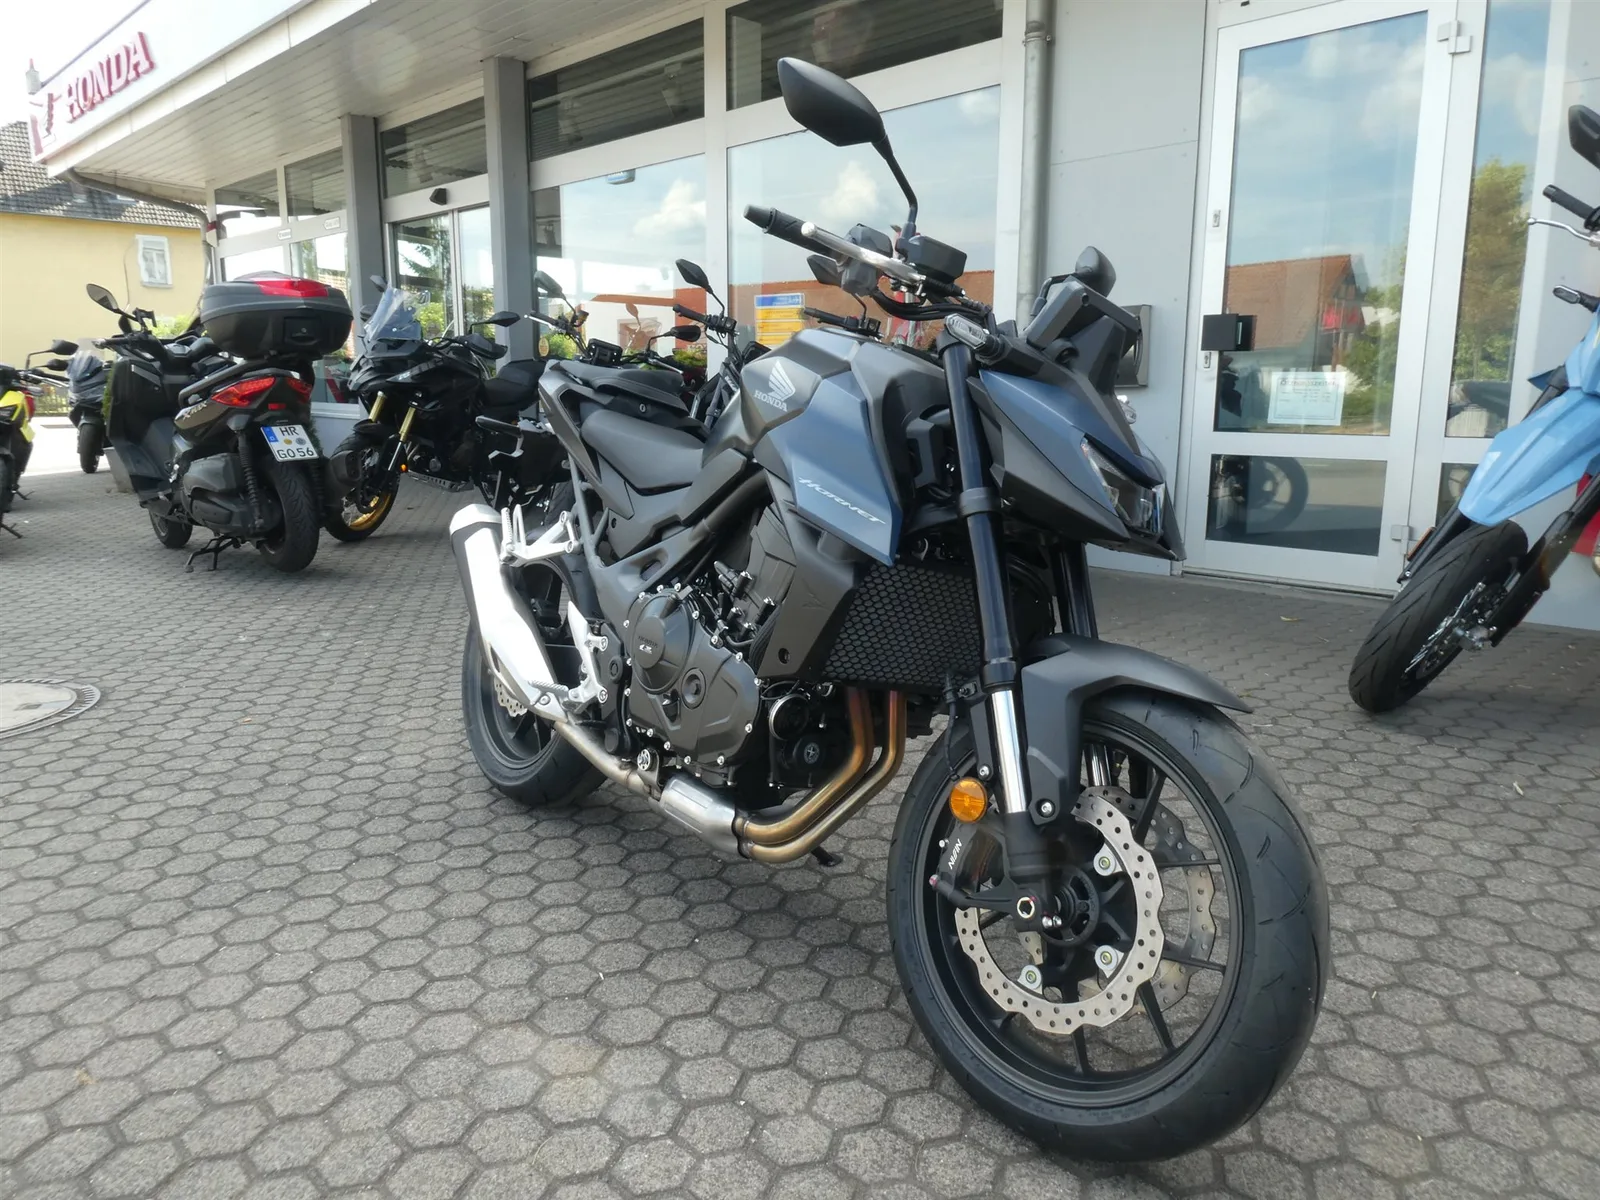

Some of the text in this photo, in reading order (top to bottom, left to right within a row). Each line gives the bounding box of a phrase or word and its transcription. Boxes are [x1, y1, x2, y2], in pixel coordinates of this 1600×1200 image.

[64, 31, 156, 124] HONDA
[753, 389, 788, 412] HONDA
[279, 426, 300, 437] HR
[276, 447, 315, 459] GO 56
